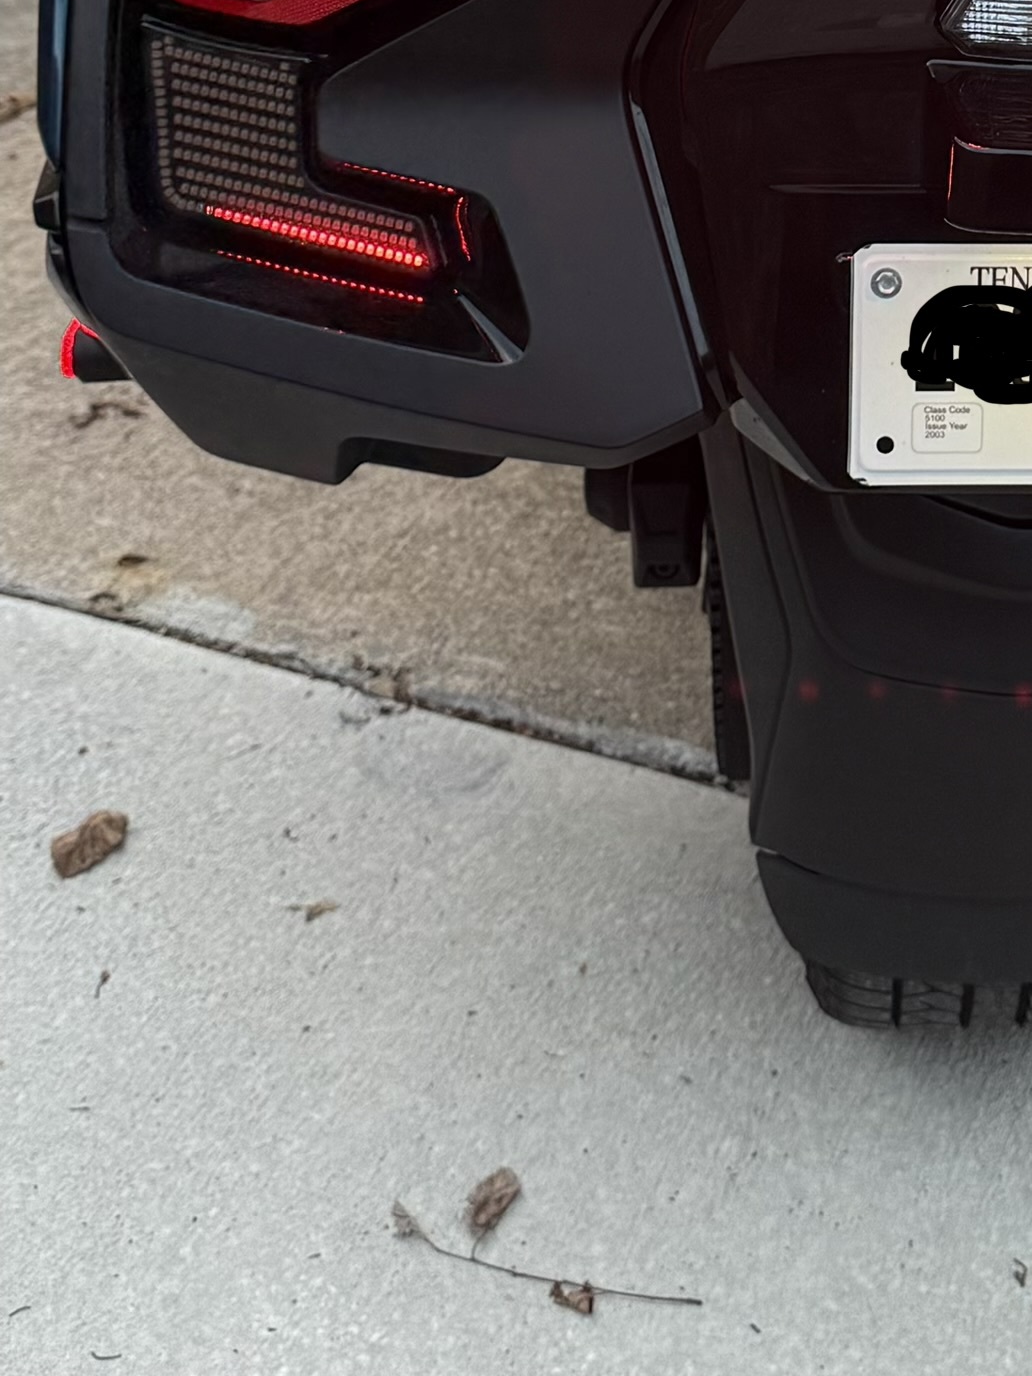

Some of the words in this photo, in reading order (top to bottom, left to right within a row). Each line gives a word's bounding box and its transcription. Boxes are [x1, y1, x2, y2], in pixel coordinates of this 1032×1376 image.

[924, 405, 947, 414] Class
[949, 405, 971, 414] Code
[925, 414, 946, 422] 5100
[925, 422, 947, 430] Issue
[949, 422, 968, 430] Year
[925, 431, 945, 439] 2003
